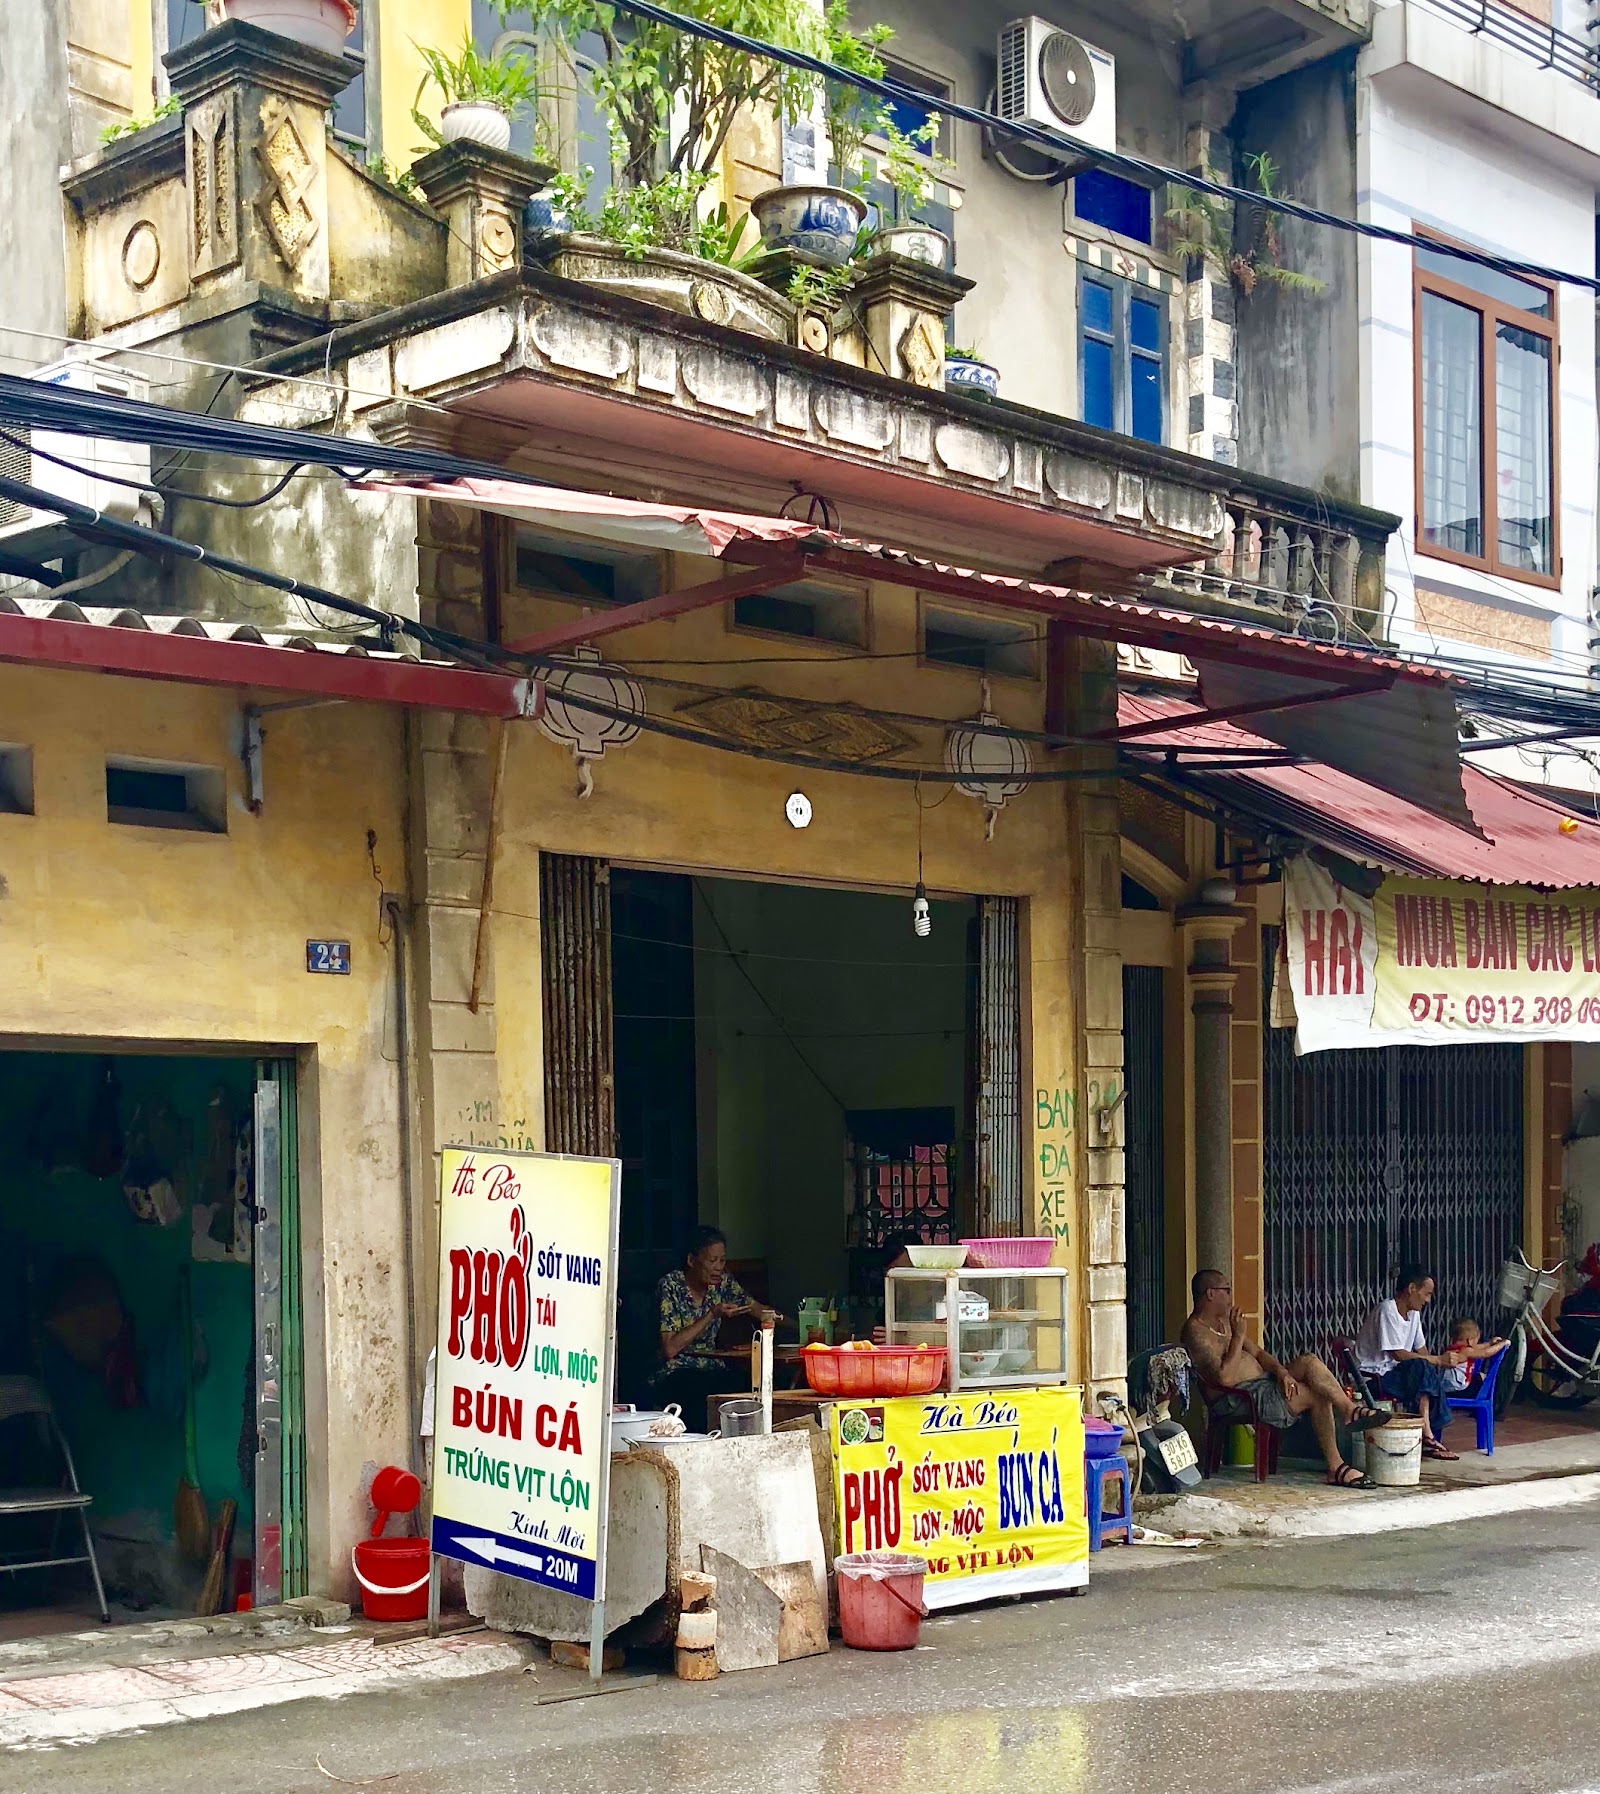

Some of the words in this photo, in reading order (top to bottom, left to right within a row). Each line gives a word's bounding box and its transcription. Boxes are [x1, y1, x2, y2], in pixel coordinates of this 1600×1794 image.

[1393, 894, 1458, 968] MUA
[1464, 884, 1518, 970] BÁN
[317, 944, 342, 970] 24
[1408, 993, 1455, 1022] ĐT:
[1465, 994, 1525, 1024] 0912
[1040, 1131, 1071, 1178] ĐÁ
[452, 1155, 476, 1197] Hà
[482, 1164, 521, 1201] Béo
[1040, 1189, 1066, 1218] XE
[537, 1243, 562, 1280] SỐT
[566, 1253, 602, 1286] VANG
[448, 1205, 531, 1369] PHỞ
[536, 1293, 557, 1328] TÁI
[534, 1345, 563, 1380] LỢN,
[568, 1348, 599, 1387] MỘC
[452, 1383, 523, 1441] BÚN
[535, 1401, 583, 1456] CÁ
[922, 1404, 964, 1430] Hà
[972, 1401, 1020, 1426] Béo
[444, 1447, 510, 1490] TRỨNG
[514, 1463, 546, 1503] VỊT
[550, 1469, 590, 1513] LỘN
[913, 1451, 941, 1493] SỐT
[945, 1459, 986, 1489] VANG
[998, 1430, 1035, 1530] BÚN
[1038, 1427, 1064, 1524] CÁ
[844, 1446, 904, 1555] PHỞ
[553, 1525, 586, 1550] Mời
[913, 1510, 942, 1548] LỢN
[951, 1500, 985, 1541] MỘC
[545, 1555, 578, 1584] 20M
[957, 1551, 991, 1574] VỊT
[996, 1543, 1034, 1568] LỘN
